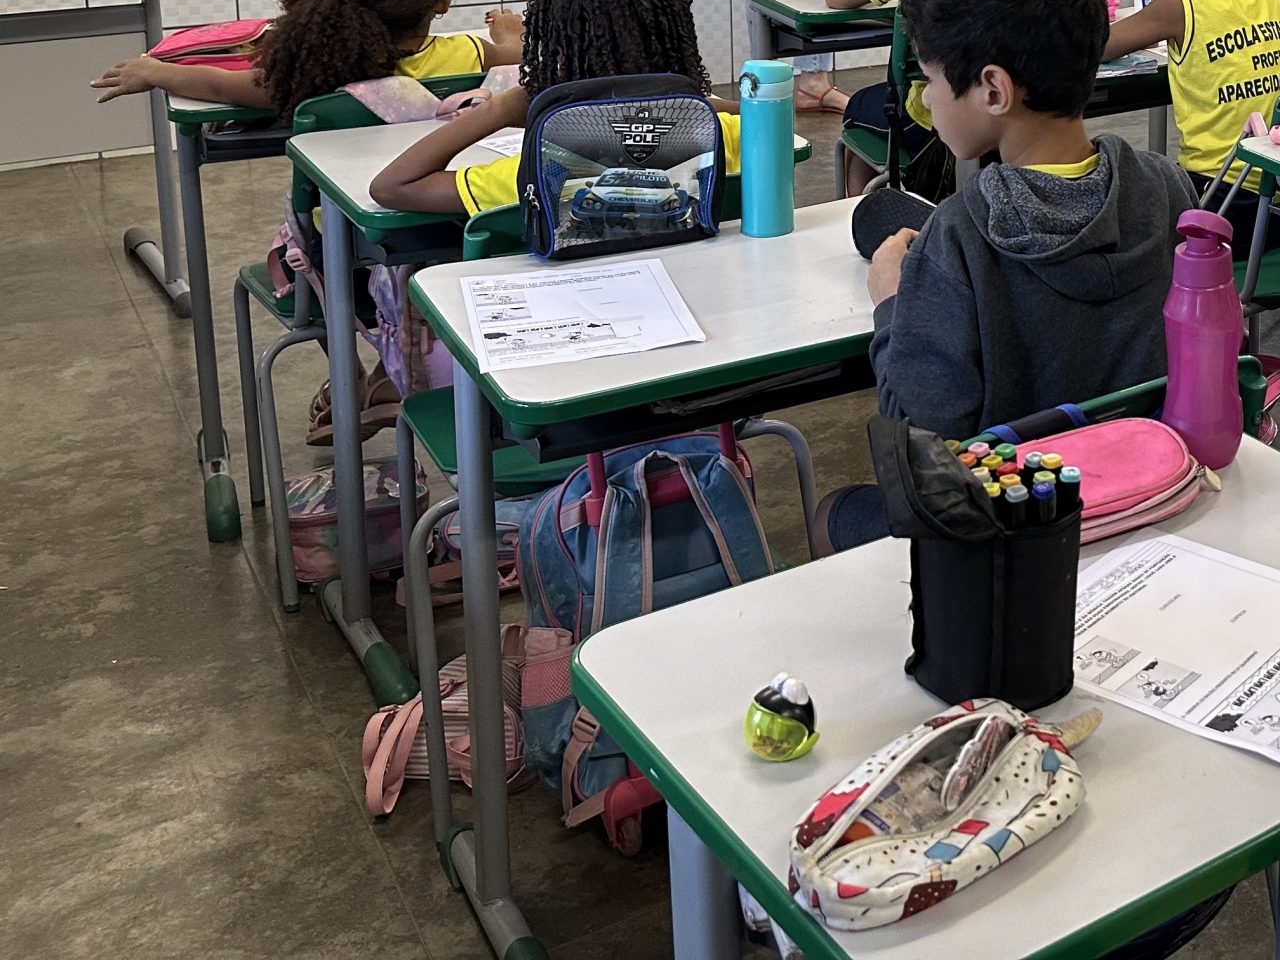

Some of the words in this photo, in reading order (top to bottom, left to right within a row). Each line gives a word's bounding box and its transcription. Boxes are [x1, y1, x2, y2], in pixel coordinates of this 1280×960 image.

[1205, 25, 1261, 62] ESCOLA
[631, 124, 654, 132] GP
[623, 133, 660, 143] POLE
